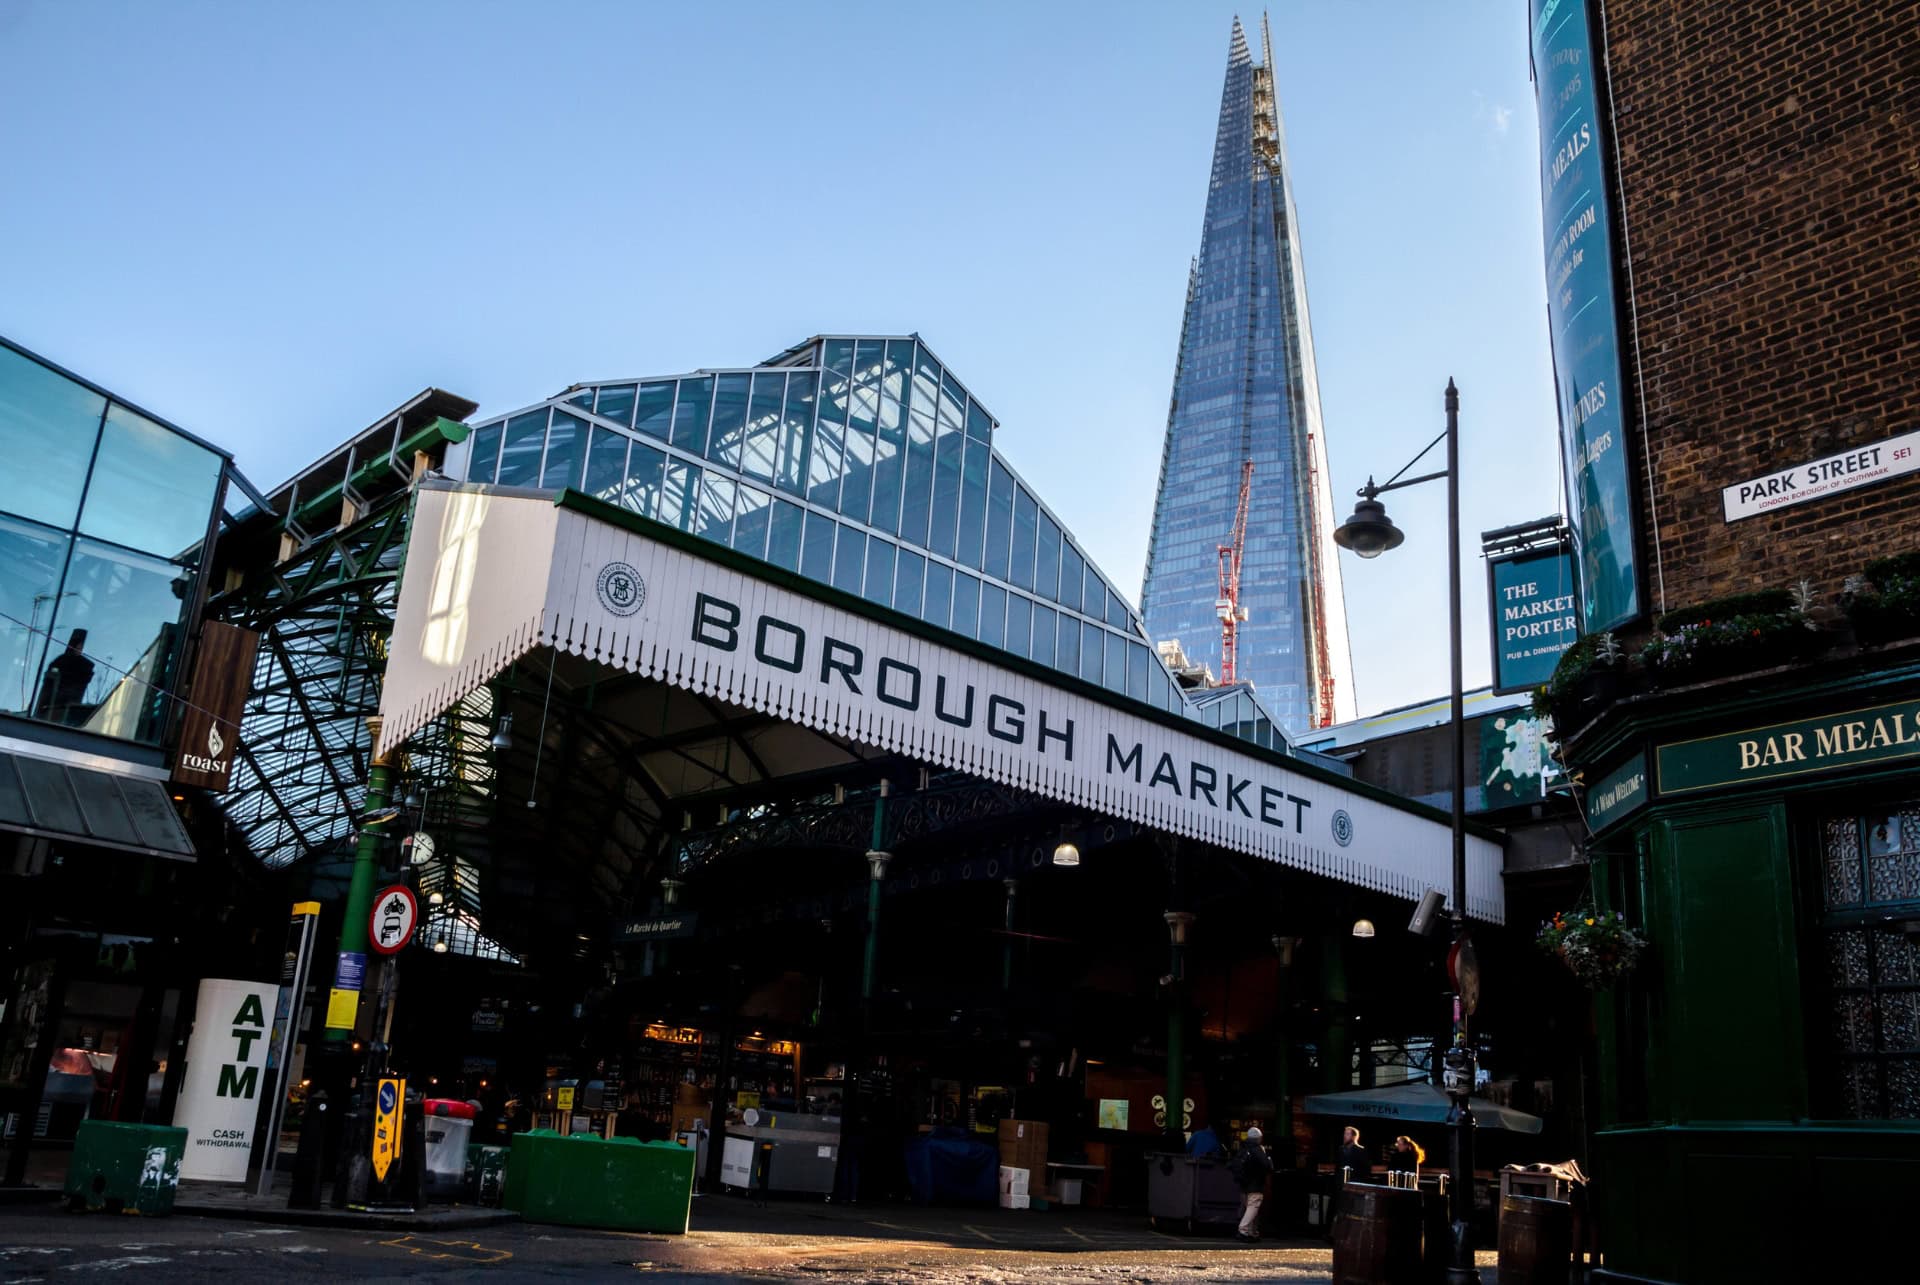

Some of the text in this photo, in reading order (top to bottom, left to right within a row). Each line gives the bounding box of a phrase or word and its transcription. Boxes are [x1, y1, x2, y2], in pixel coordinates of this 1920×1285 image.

[1569, 205, 1596, 245] ROOM
[1573, 381, 1607, 429] WINES
[1740, 447, 1912, 504] PARK STREET SE1
[1759, 467, 1889, 509] LONDON BOROUGH OF SOUTHWARK
[1503, 582, 1538, 601] THE
[1504, 594, 1575, 621] MARKET
[1505, 615, 1577, 641] PORTER
[1507, 652, 1522, 660] PUB
[1533, 644, 1560, 655] DINING
[691, 591, 1312, 834] BOROUGH MARKET
[182, 753, 228, 774] roast
[1738, 732, 1807, 770] BAR
[217, 994, 265, 1099] ATM
[213, 1129, 245, 1139] CASH
